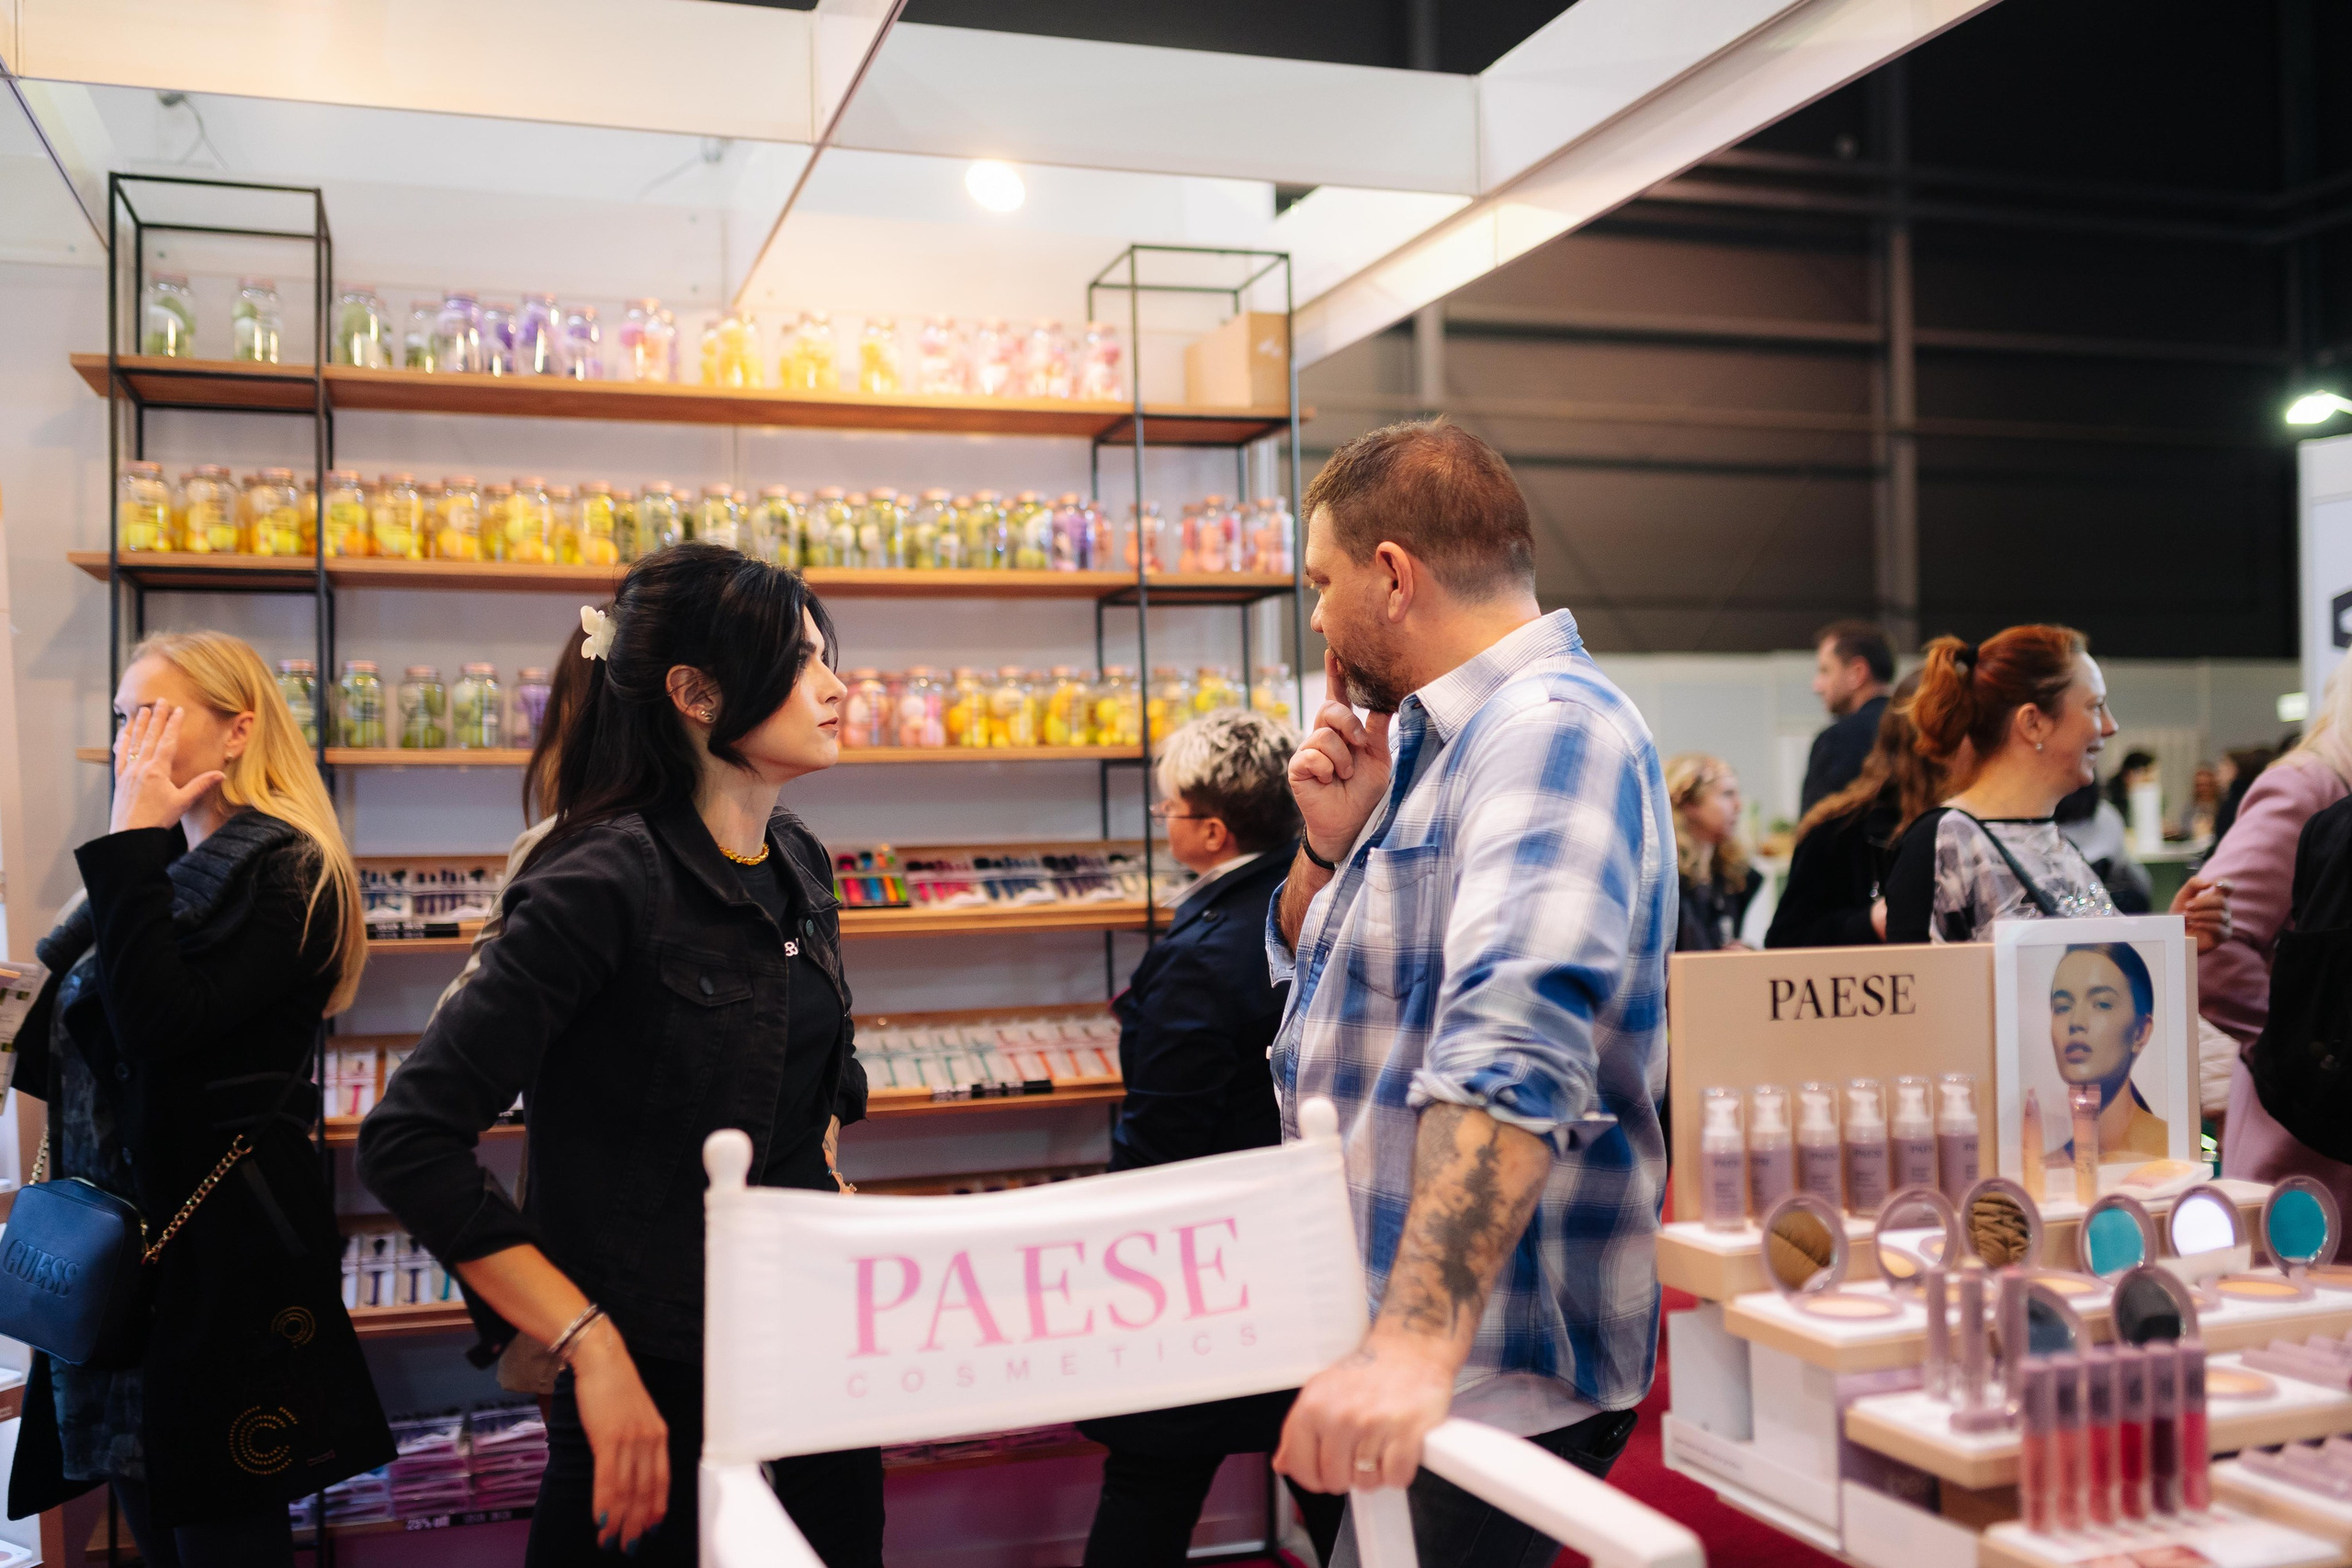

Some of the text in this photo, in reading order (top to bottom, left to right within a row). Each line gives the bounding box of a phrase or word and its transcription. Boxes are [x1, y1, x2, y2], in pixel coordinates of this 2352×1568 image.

[1769, 974, 1917, 1021] PAESE
[3, 1238, 80, 1298] GUESS
[847, 1218, 1250, 1359] PAESE
[846, 1323, 1258, 1398] COSMETICS
